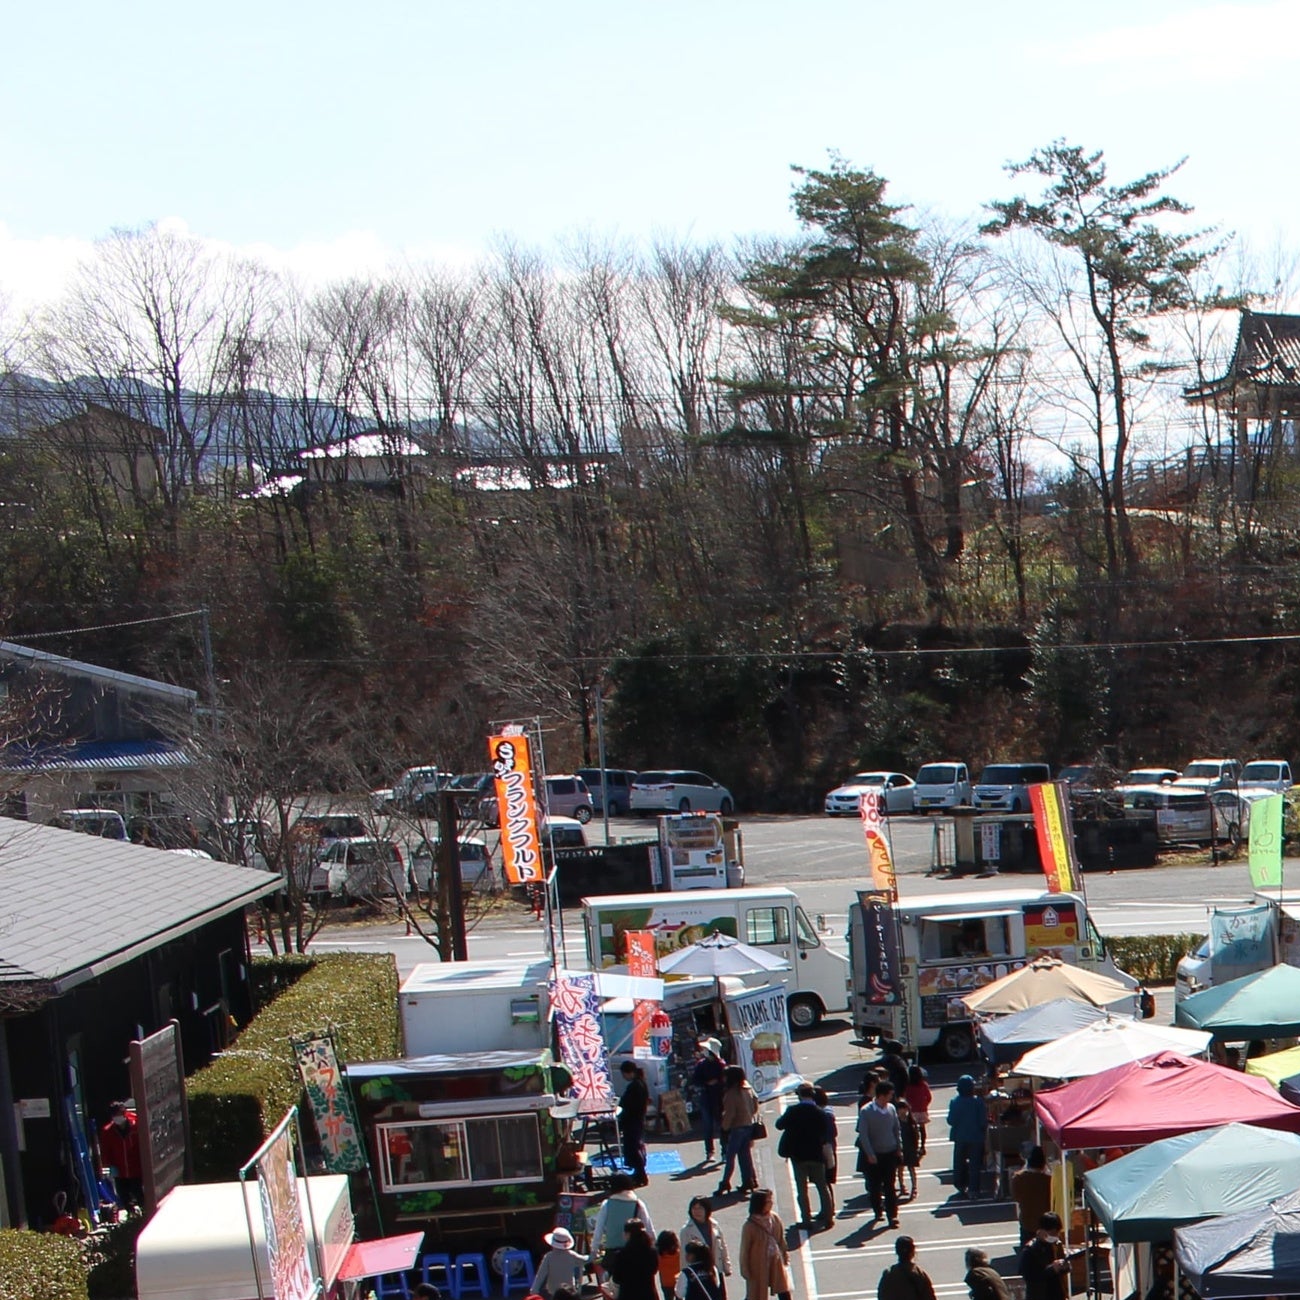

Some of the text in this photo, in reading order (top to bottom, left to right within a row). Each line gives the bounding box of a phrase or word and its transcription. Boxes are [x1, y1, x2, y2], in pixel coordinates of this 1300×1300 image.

[502, 771, 536, 882] フランクフルト
